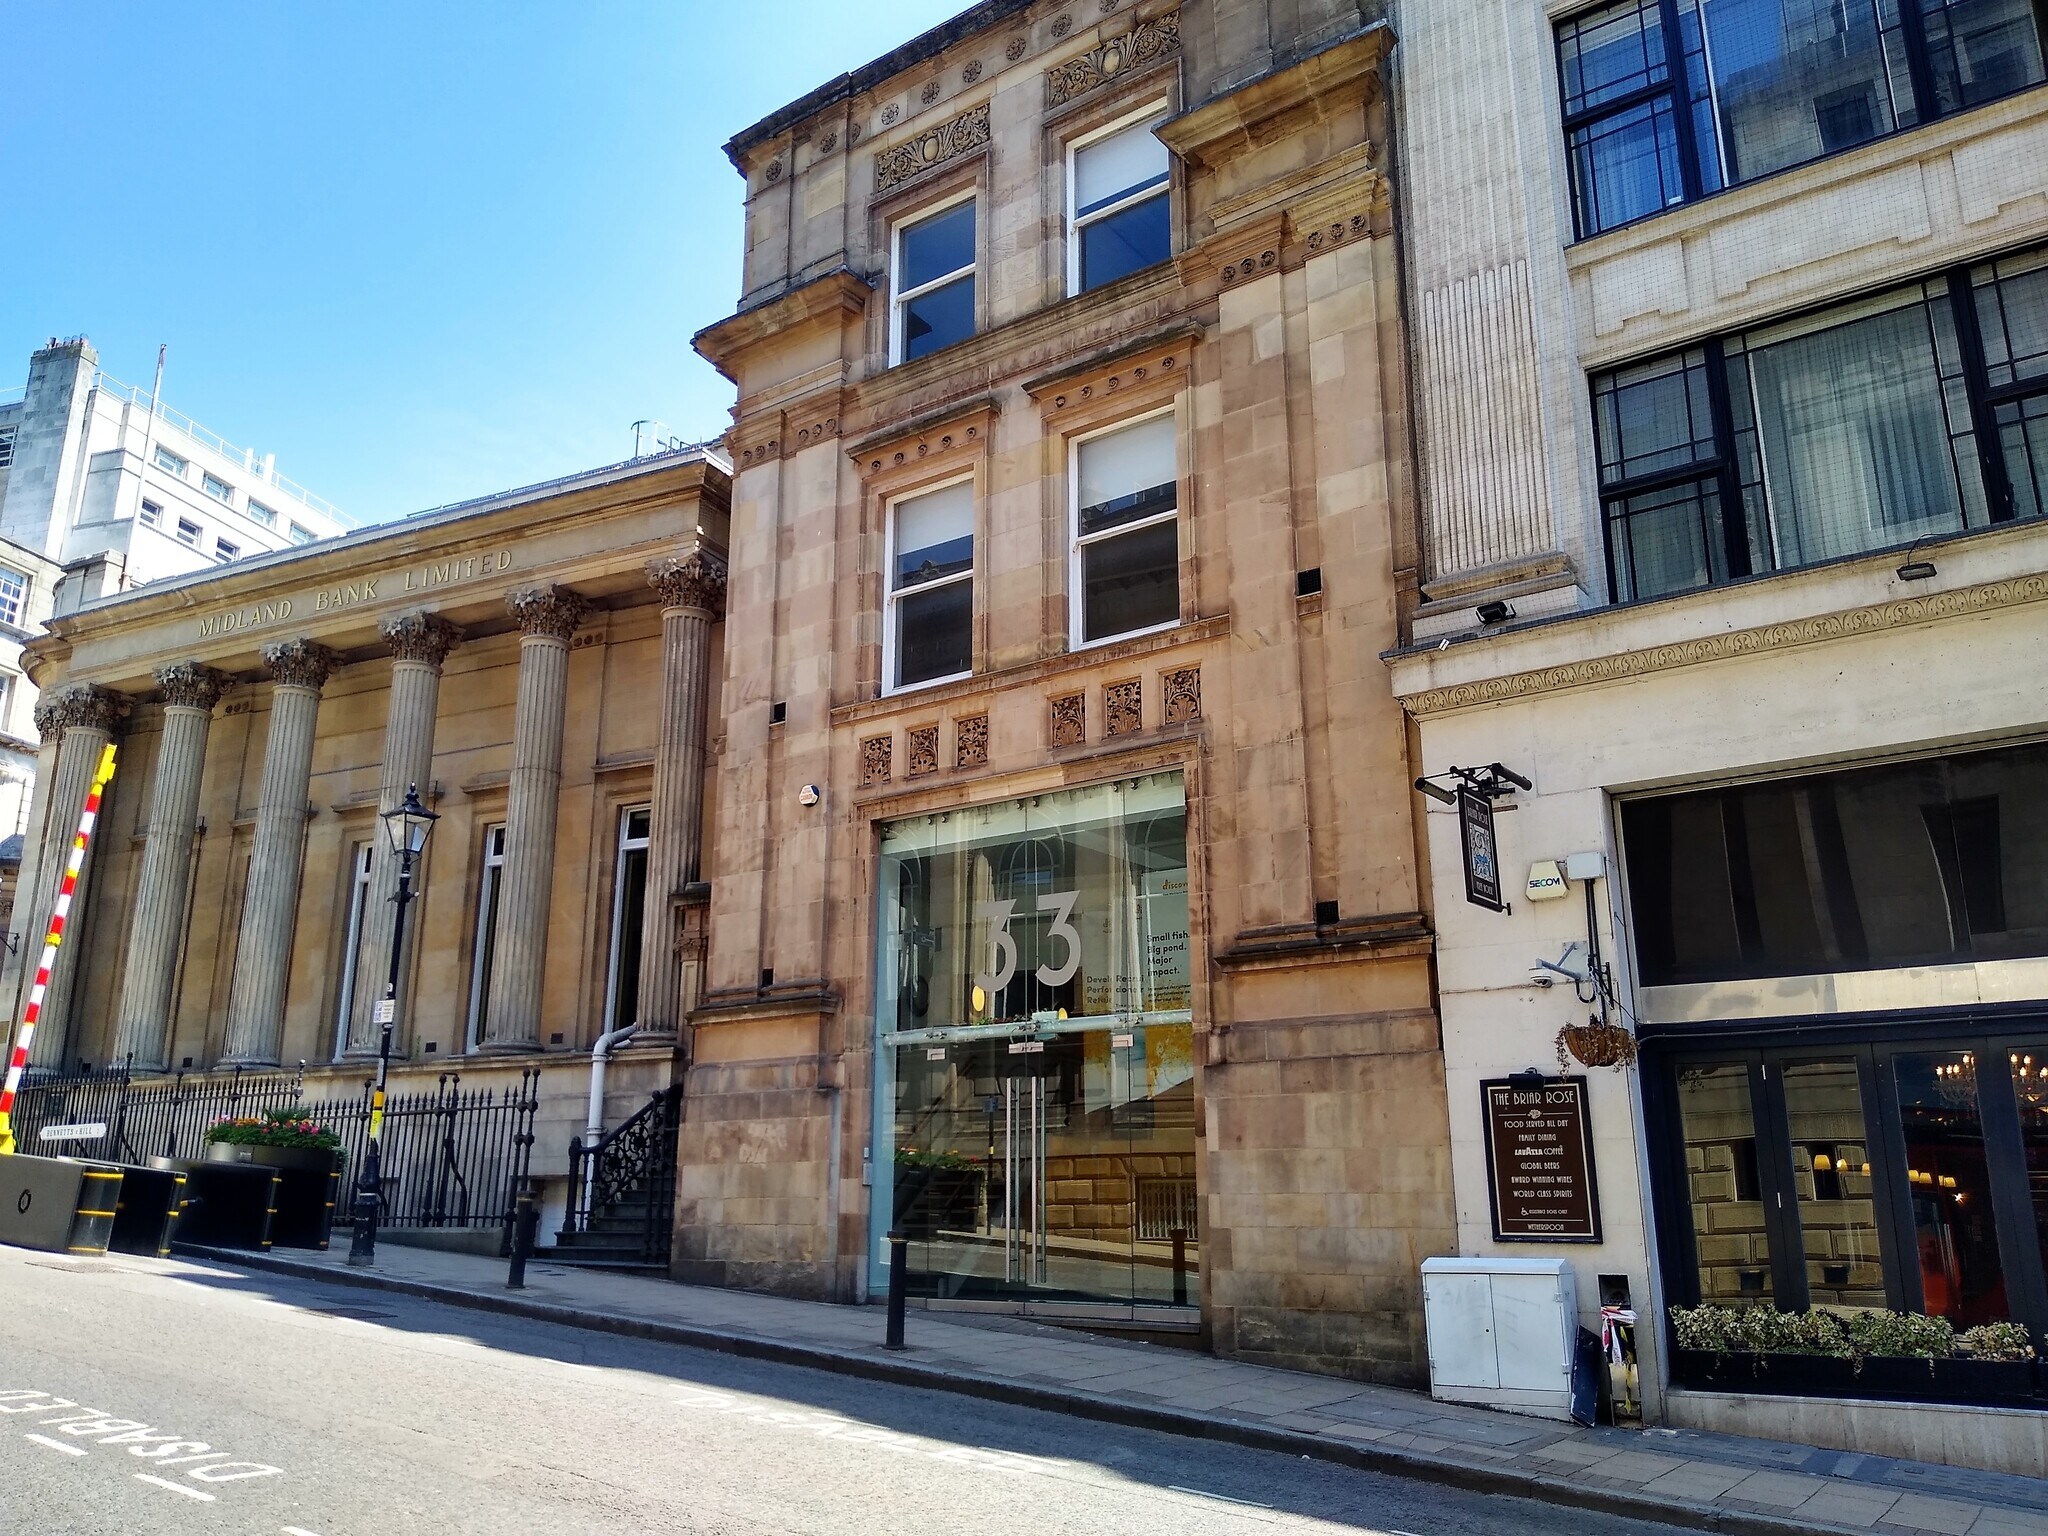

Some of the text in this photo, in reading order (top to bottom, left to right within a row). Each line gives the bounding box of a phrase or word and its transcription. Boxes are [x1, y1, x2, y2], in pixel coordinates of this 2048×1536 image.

[198, 550, 513, 638] MIDLAND BANK LIMITED
[1529, 877, 1560, 888] SECOM
[974, 890, 1082, 993] 33
[1147, 932, 1170, 943] Small
[1163, 942, 1187, 954] pond.
[1147, 956, 1172, 966] Major
[1147, 966, 1180, 977] impact.
[1494, 1091, 1575, 1105] THE BRIAR ROSE
[1515, 1147, 1543, 1156] LAVAZZA
[1513, 1190, 1573, 1198] WORLD CLASS SPIRITS
[1527, 1223, 1565, 1231] WETHERSPOON
